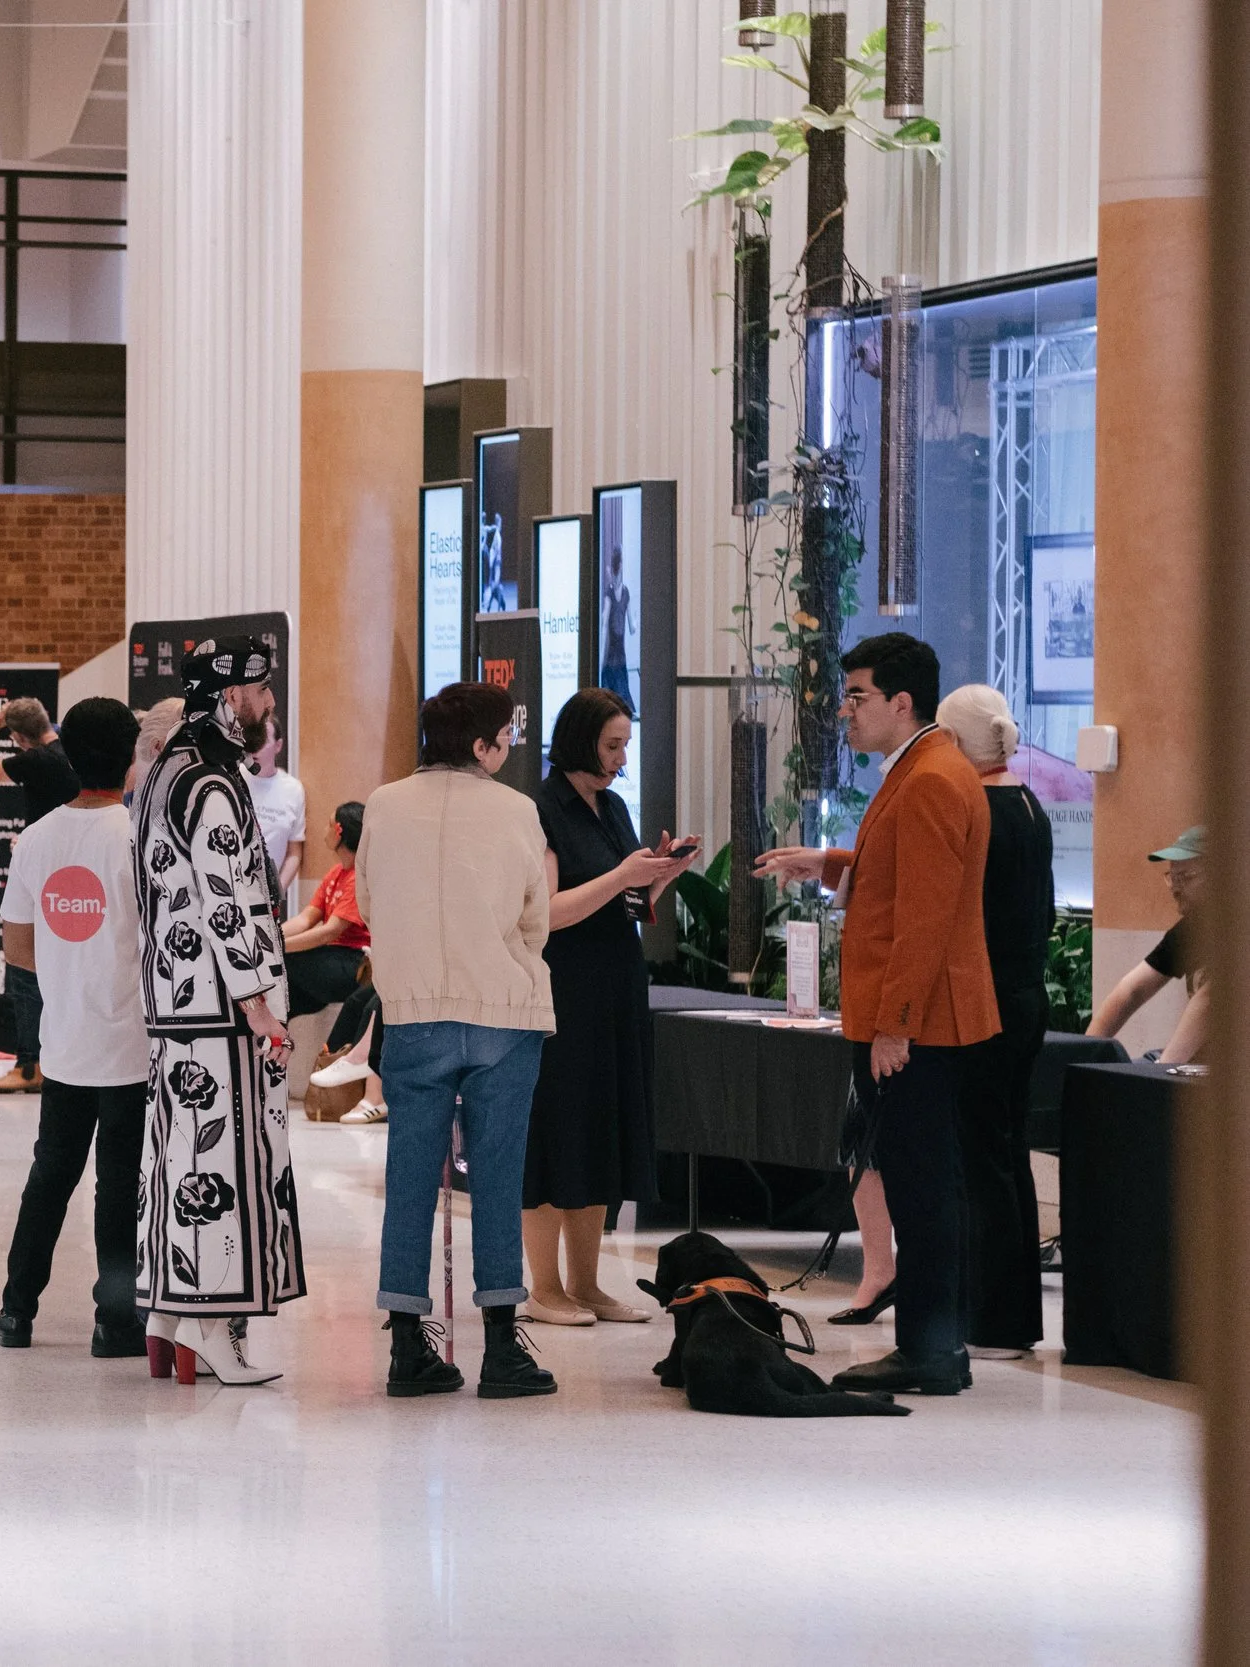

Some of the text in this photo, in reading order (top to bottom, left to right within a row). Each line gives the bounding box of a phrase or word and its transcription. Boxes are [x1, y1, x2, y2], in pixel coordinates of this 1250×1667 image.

[430, 531, 461, 553] Elastic
[430, 558, 461, 578] Hearts
[543, 611, 579, 634] Hamlet
[45, 893, 107, 915] Team.
